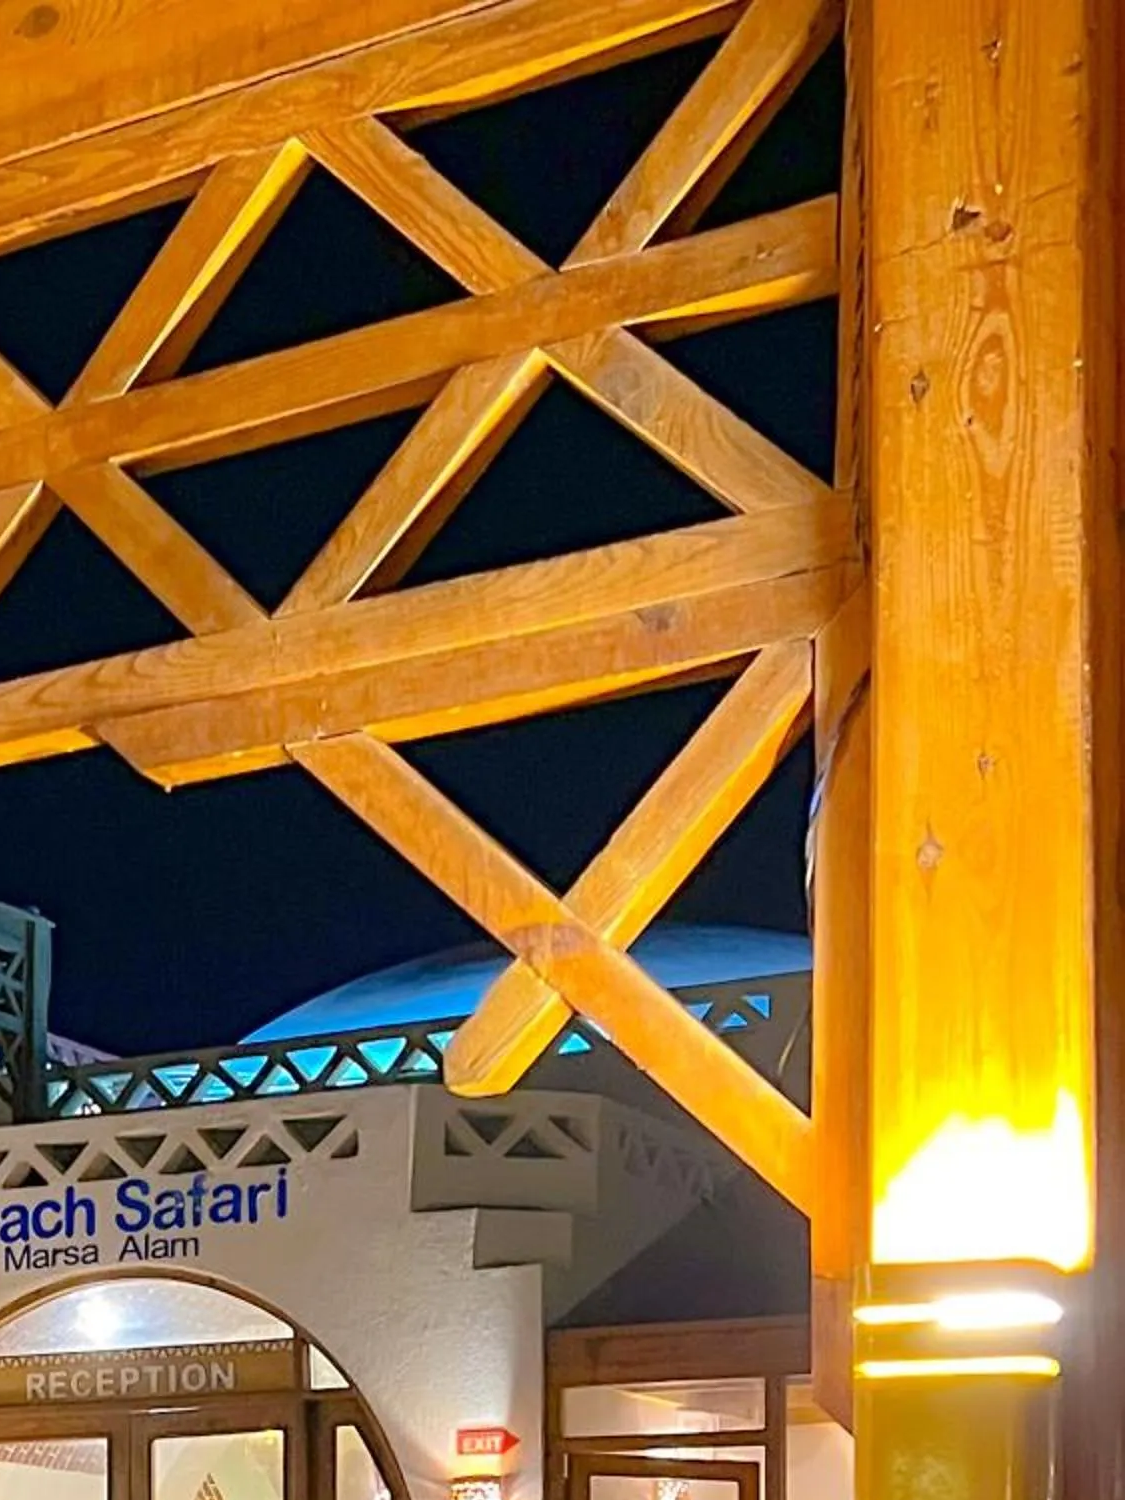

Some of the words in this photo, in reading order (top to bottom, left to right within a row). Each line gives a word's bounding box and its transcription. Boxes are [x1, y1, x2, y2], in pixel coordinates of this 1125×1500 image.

[115, 1167, 288, 1233] Safari
[4, 1243, 99, 1272] Marsa
[118, 1232, 200, 1262] Alam
[25, 1361, 236, 1400] RECEPTION
[462, 1434, 503, 1450] EXIT
